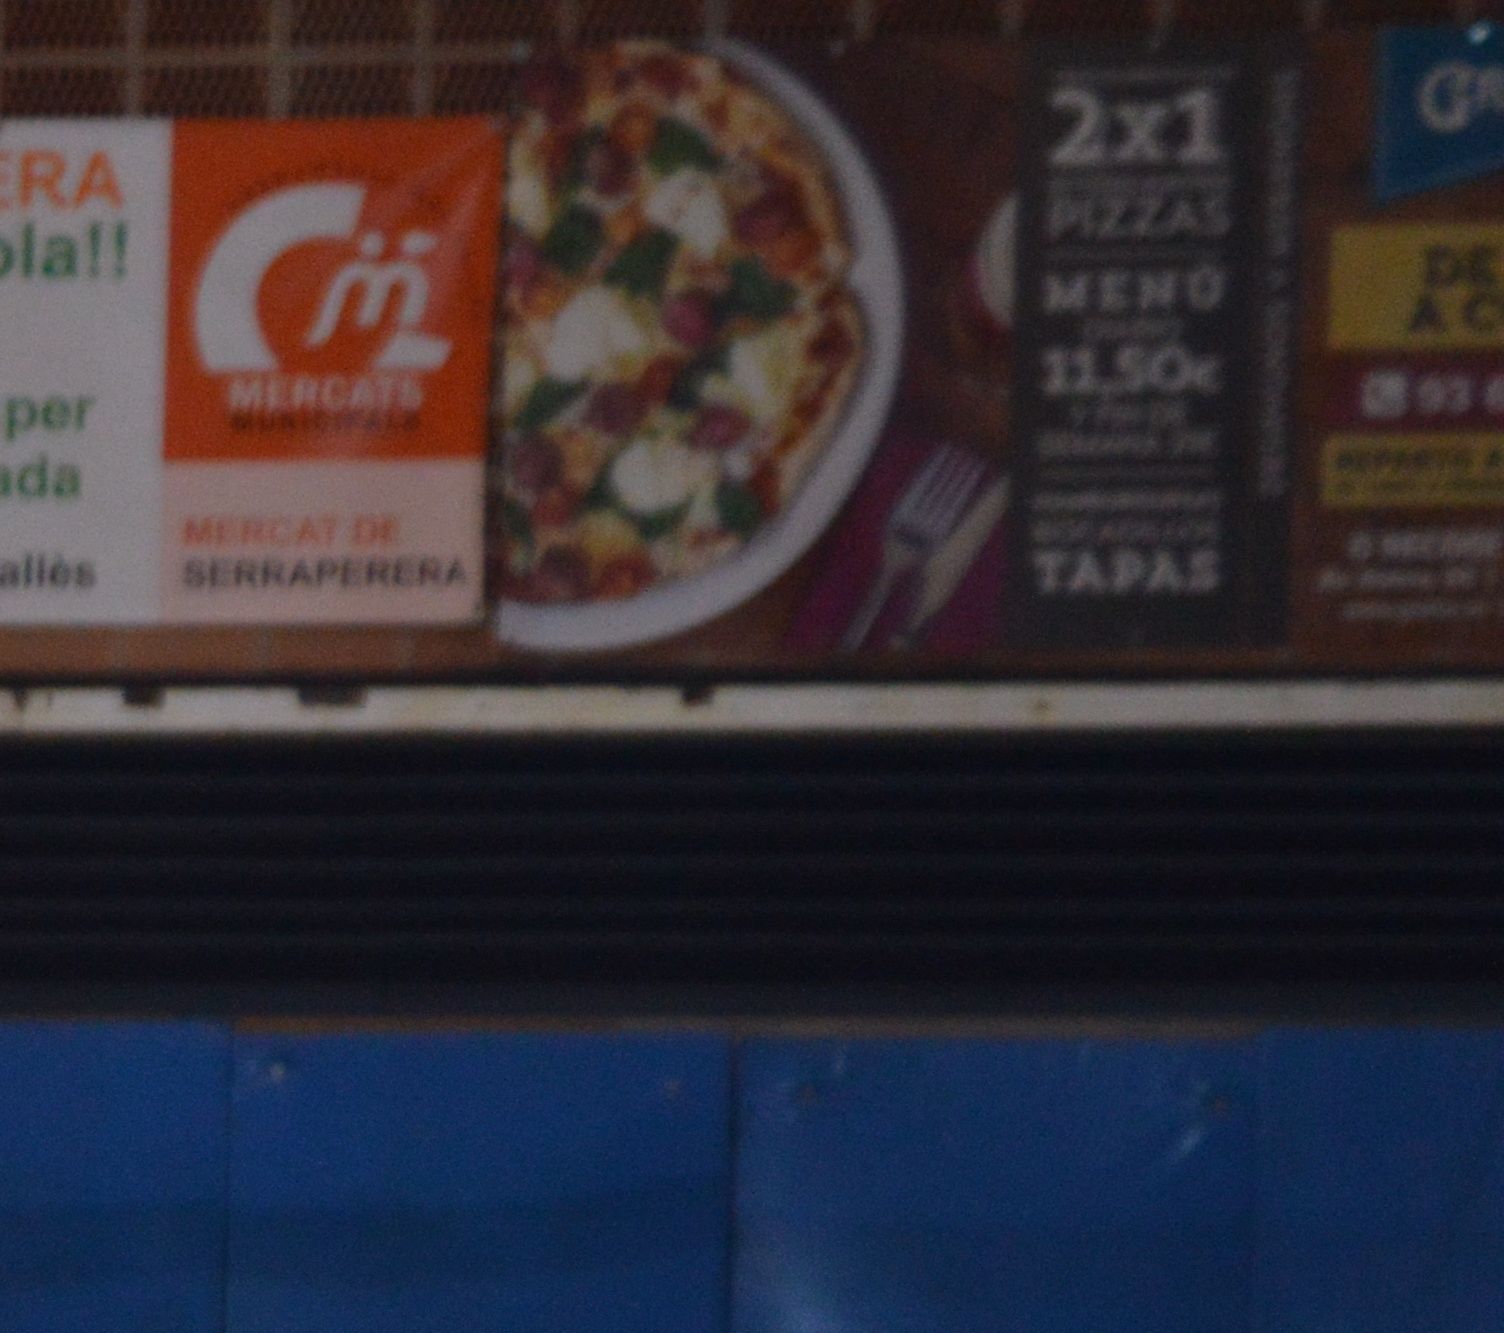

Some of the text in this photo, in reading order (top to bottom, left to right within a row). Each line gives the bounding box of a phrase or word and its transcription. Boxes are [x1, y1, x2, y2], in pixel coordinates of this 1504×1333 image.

[1048, 88, 1226, 167] 2x1
[229, 376, 424, 412] MERCATS
[5, 394, 97, 441] per
[182, 515, 399, 547] MERCAT DE
[182, 556, 468, 588] SERRAPERERA
[1035, 550, 1222, 593] TAPAS
